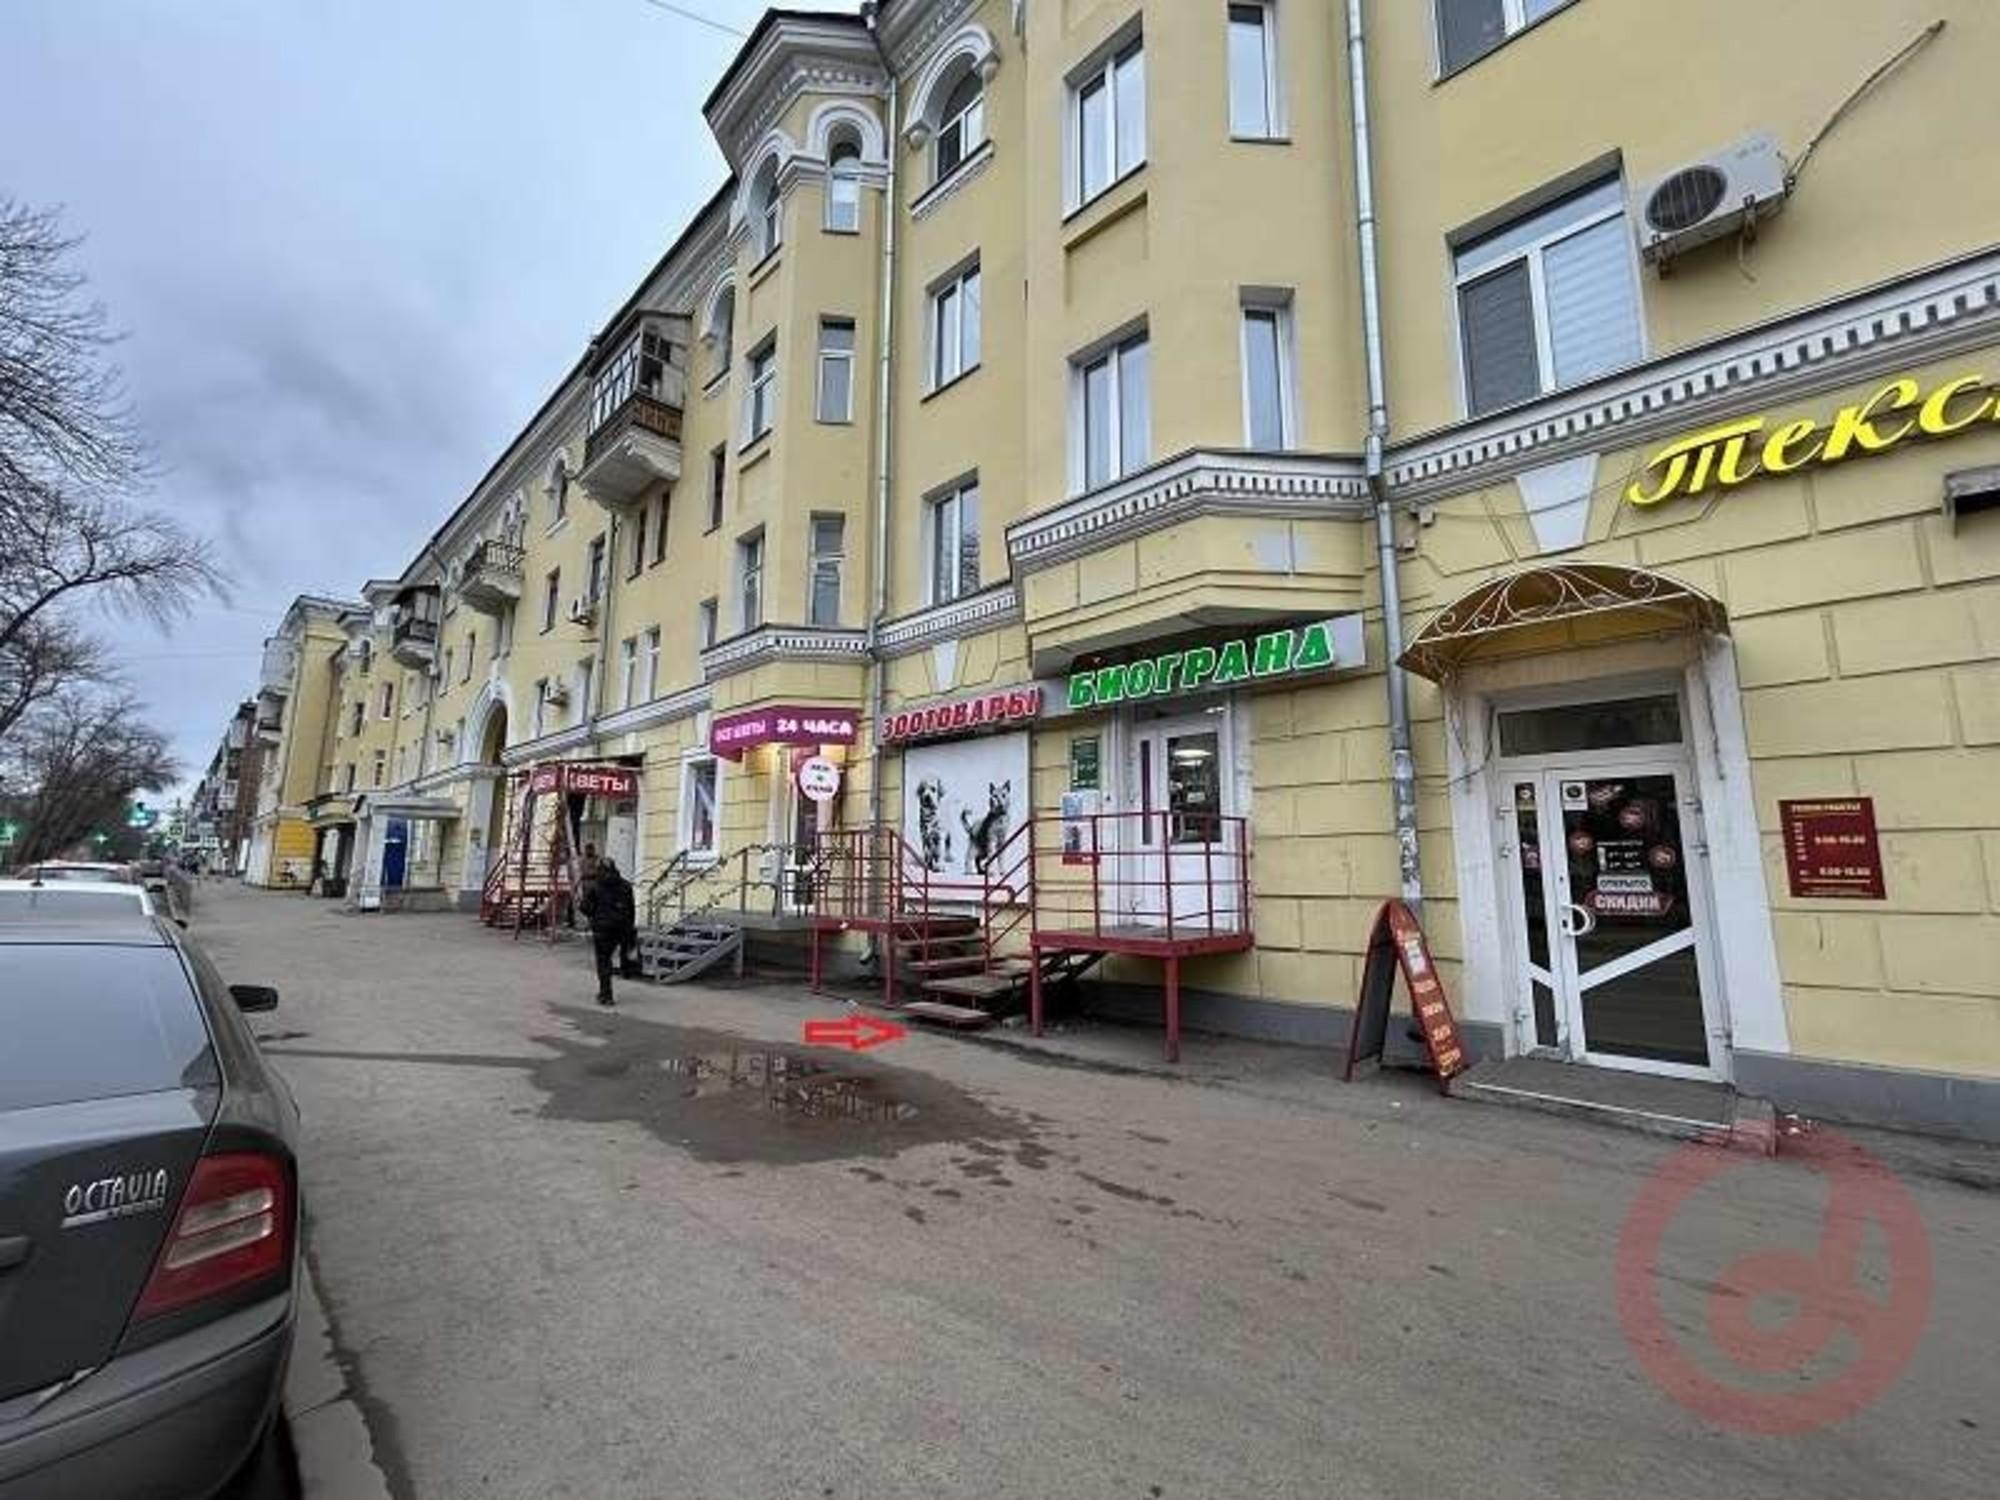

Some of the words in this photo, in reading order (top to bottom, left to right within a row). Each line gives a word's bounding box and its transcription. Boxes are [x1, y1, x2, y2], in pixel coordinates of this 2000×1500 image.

[1628, 374, 2000, 504] Текс
[1067, 622, 1335, 709] БИОГРАНД
[776, 718, 798, 733] 24
[802, 719, 852, 735] ЧАСА
[881, 686, 1042, 742] ЗООТОВАРЫ
[1594, 894, 1661, 910] СКИДКИ
[64, 1168, 167, 1214] OCTAVIA
